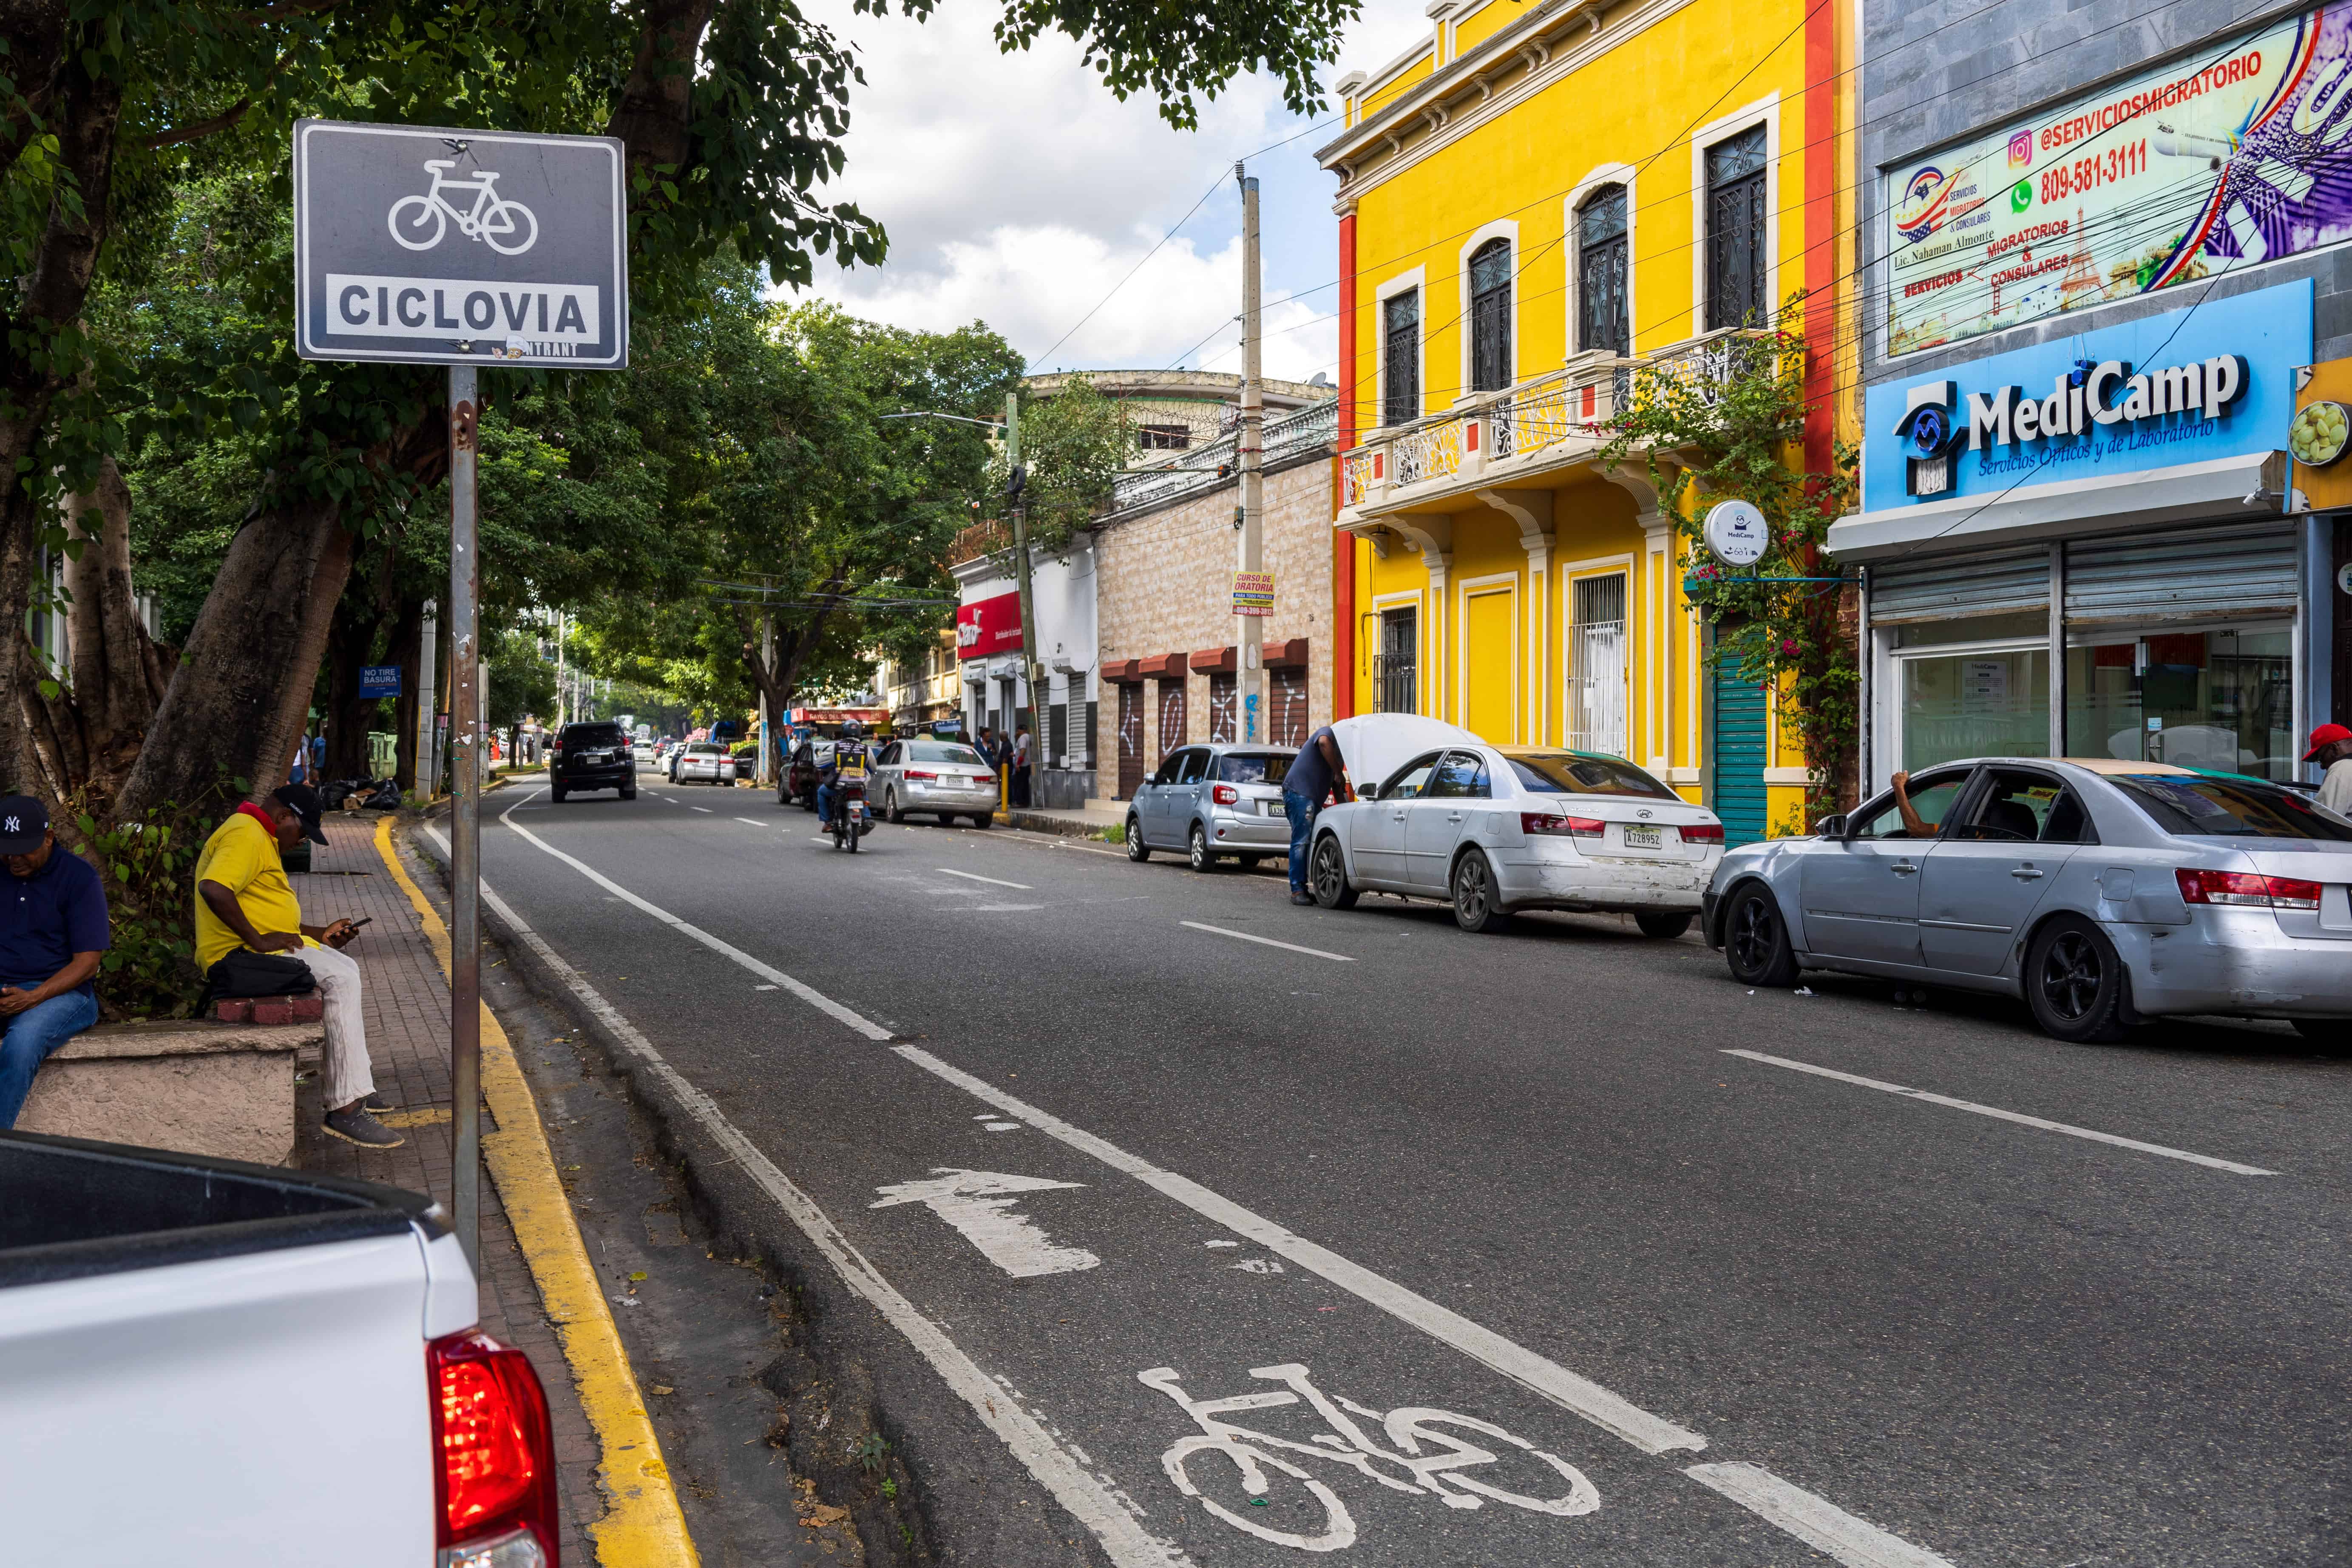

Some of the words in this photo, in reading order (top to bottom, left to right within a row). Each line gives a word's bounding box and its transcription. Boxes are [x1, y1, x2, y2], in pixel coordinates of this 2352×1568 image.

[2041, 51, 2261, 150] @SERVICIOSMIGRATORIO
[2041, 139, 2146, 205] 809-581-3111
[1950, 184, 1977, 202] SERVICIOS
[1950, 197, 1986, 217] MIGRATORIOS
[1950, 222, 1955, 233] &
[1957, 211, 1990, 232] CONSULARES
[1895, 255, 1909, 268] Lic.
[1912, 243, 1952, 262] Nahaman
[1955, 229, 1994, 246] Almonte
[1987, 220, 2069, 258] MIGRATORIOS
[2023, 245, 2032, 262] &
[1904, 269, 1963, 298] SERVICIOS
[1991, 254, 2069, 287] CONSULARES
[339, 284, 587, 333] CICLOVIA
[1967, 354, 2247, 451] MediCamp
[1979, 457, 2035, 476] Servicios
[2041, 444, 2090, 468] Opticos
[2094, 445, 2105, 463] y
[2108, 434, 2123, 453] de
[2128, 422, 2213, 451] Laboratorio
[1235, 582, 1273, 592] ORATORIA
[1237, 574, 1260, 582] CURSO
[958, 622, 980, 647] Claro
[5, 816, 20, 832] NY
[1627, 832, 1660, 845] A728952
